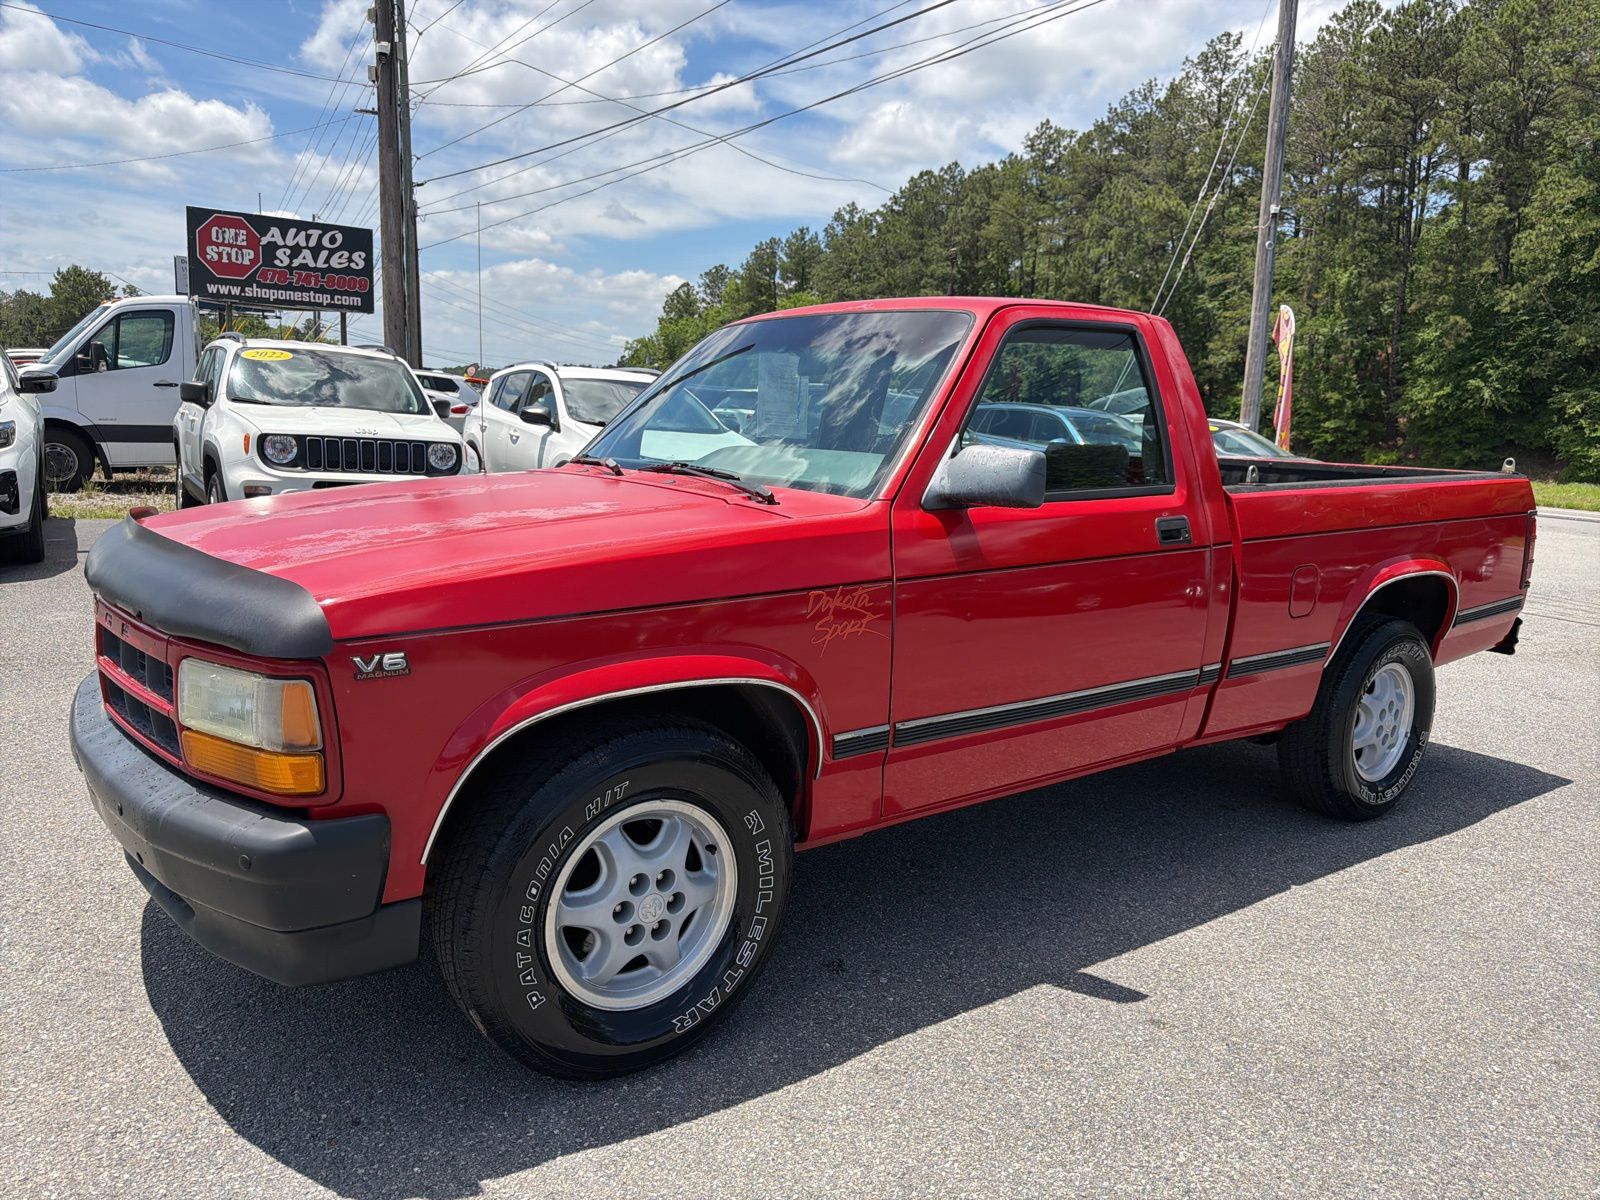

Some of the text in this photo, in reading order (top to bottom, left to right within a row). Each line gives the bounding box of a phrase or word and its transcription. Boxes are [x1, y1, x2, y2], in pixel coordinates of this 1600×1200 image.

[211, 226, 247, 246] ONE
[260, 226, 343, 249] AUTO
[206, 245, 255, 265] STOP
[257, 267, 369, 292] 478-741-8009
[207, 283, 361, 306] www.shoponestop.com
[806, 585, 888, 619] Dakota
[811, 613, 889, 657] Sport
[352, 652, 407, 673] V6
[357, 668, 409, 680] MAGNUM
[516, 826, 575, 1010] PATAGONIA
[672, 839, 774, 1034] MILESTAR
